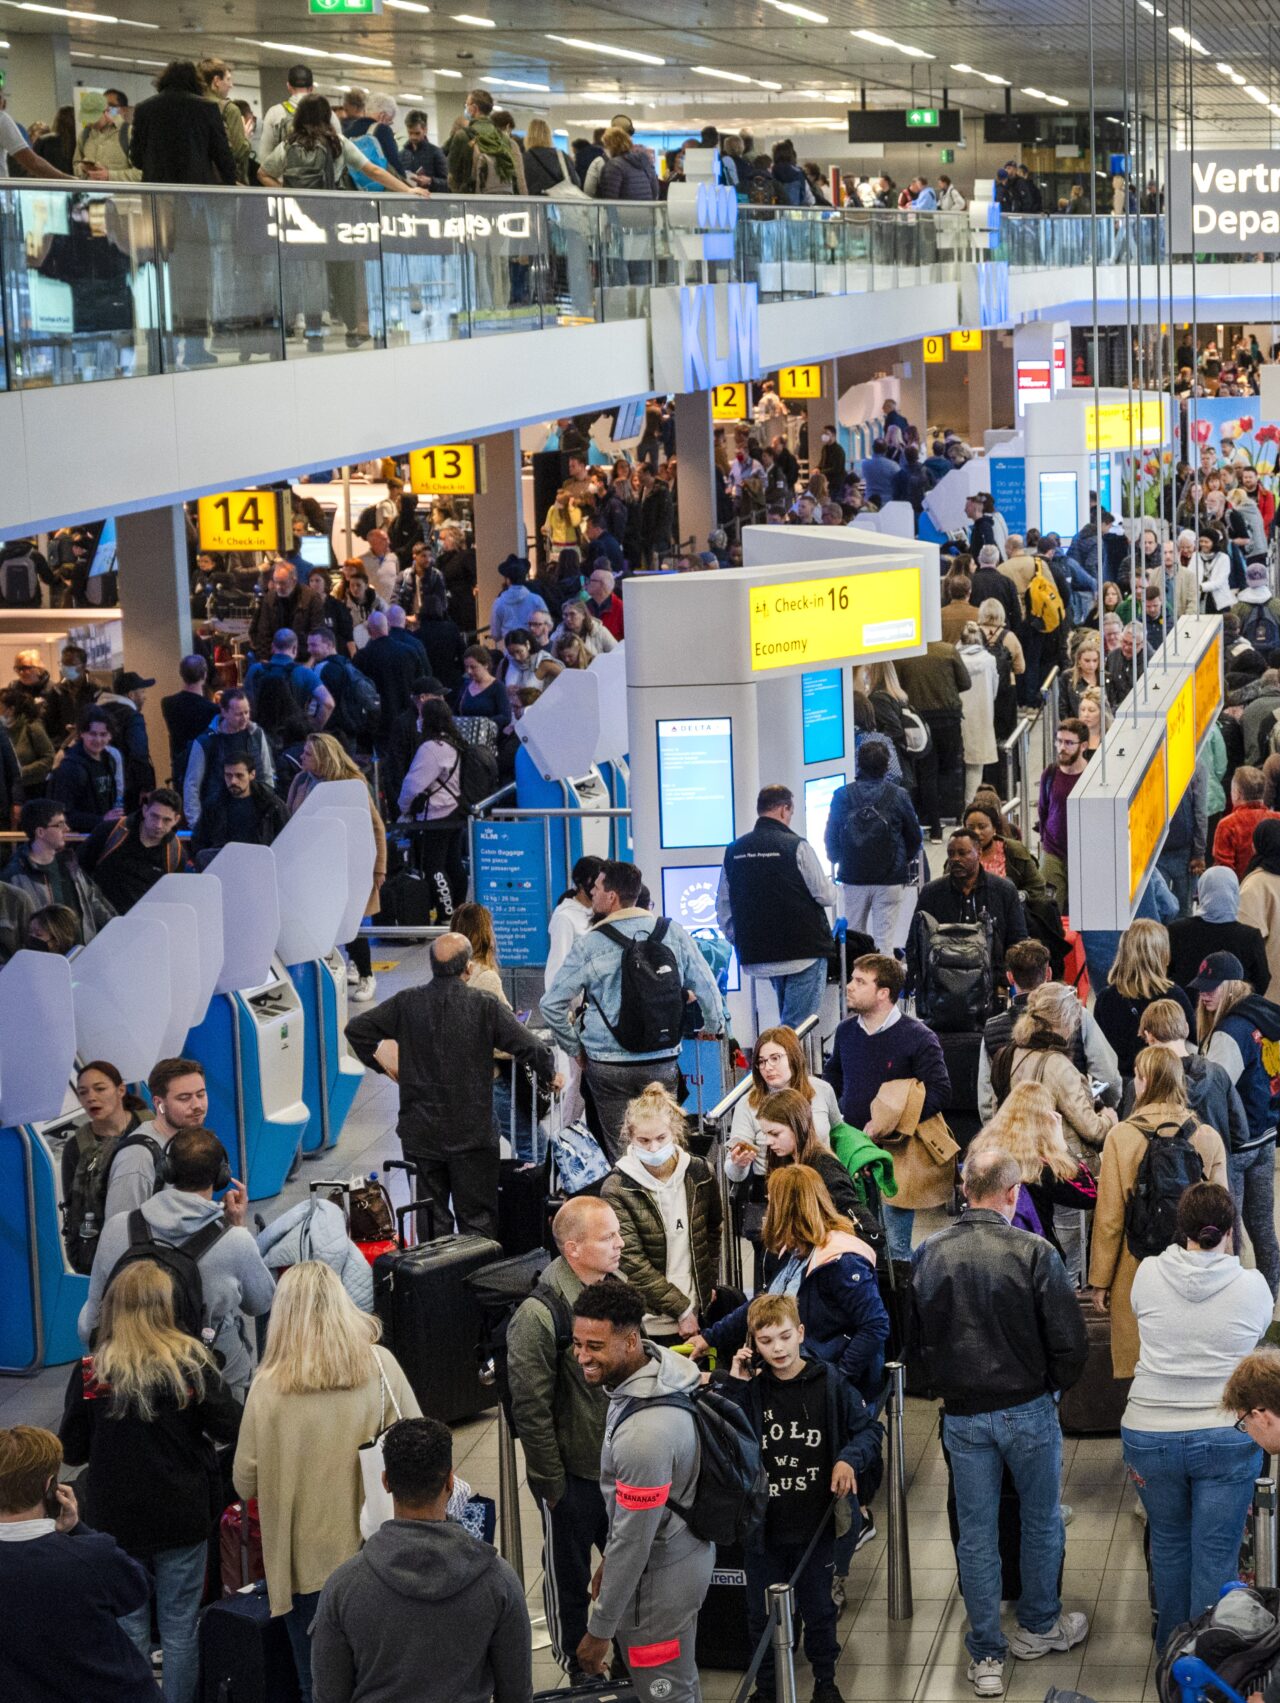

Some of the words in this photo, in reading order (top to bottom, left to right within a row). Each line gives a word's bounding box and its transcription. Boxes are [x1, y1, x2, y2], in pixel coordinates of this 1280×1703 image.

[977, 261, 1009, 326] KLM
[680, 282, 760, 393] KLM
[961, 328, 970, 343] 9
[927, 339, 937, 354] 0
[787, 369, 811, 387] 11
[712, 386, 737, 407] 12
[422, 450, 463, 479] 13
[213, 496, 264, 533] 14
[227, 537, 266, 546] Check-in
[775, 596, 824, 613] Check-in
[828, 586, 849, 611] 16
[755, 637, 808, 657] Economy
[681, 724, 712, 732] DELTA
[434, 872, 453, 915] adidas
[774, 1455, 799, 1468] WE
[766, 1467, 820, 1497] RUST
